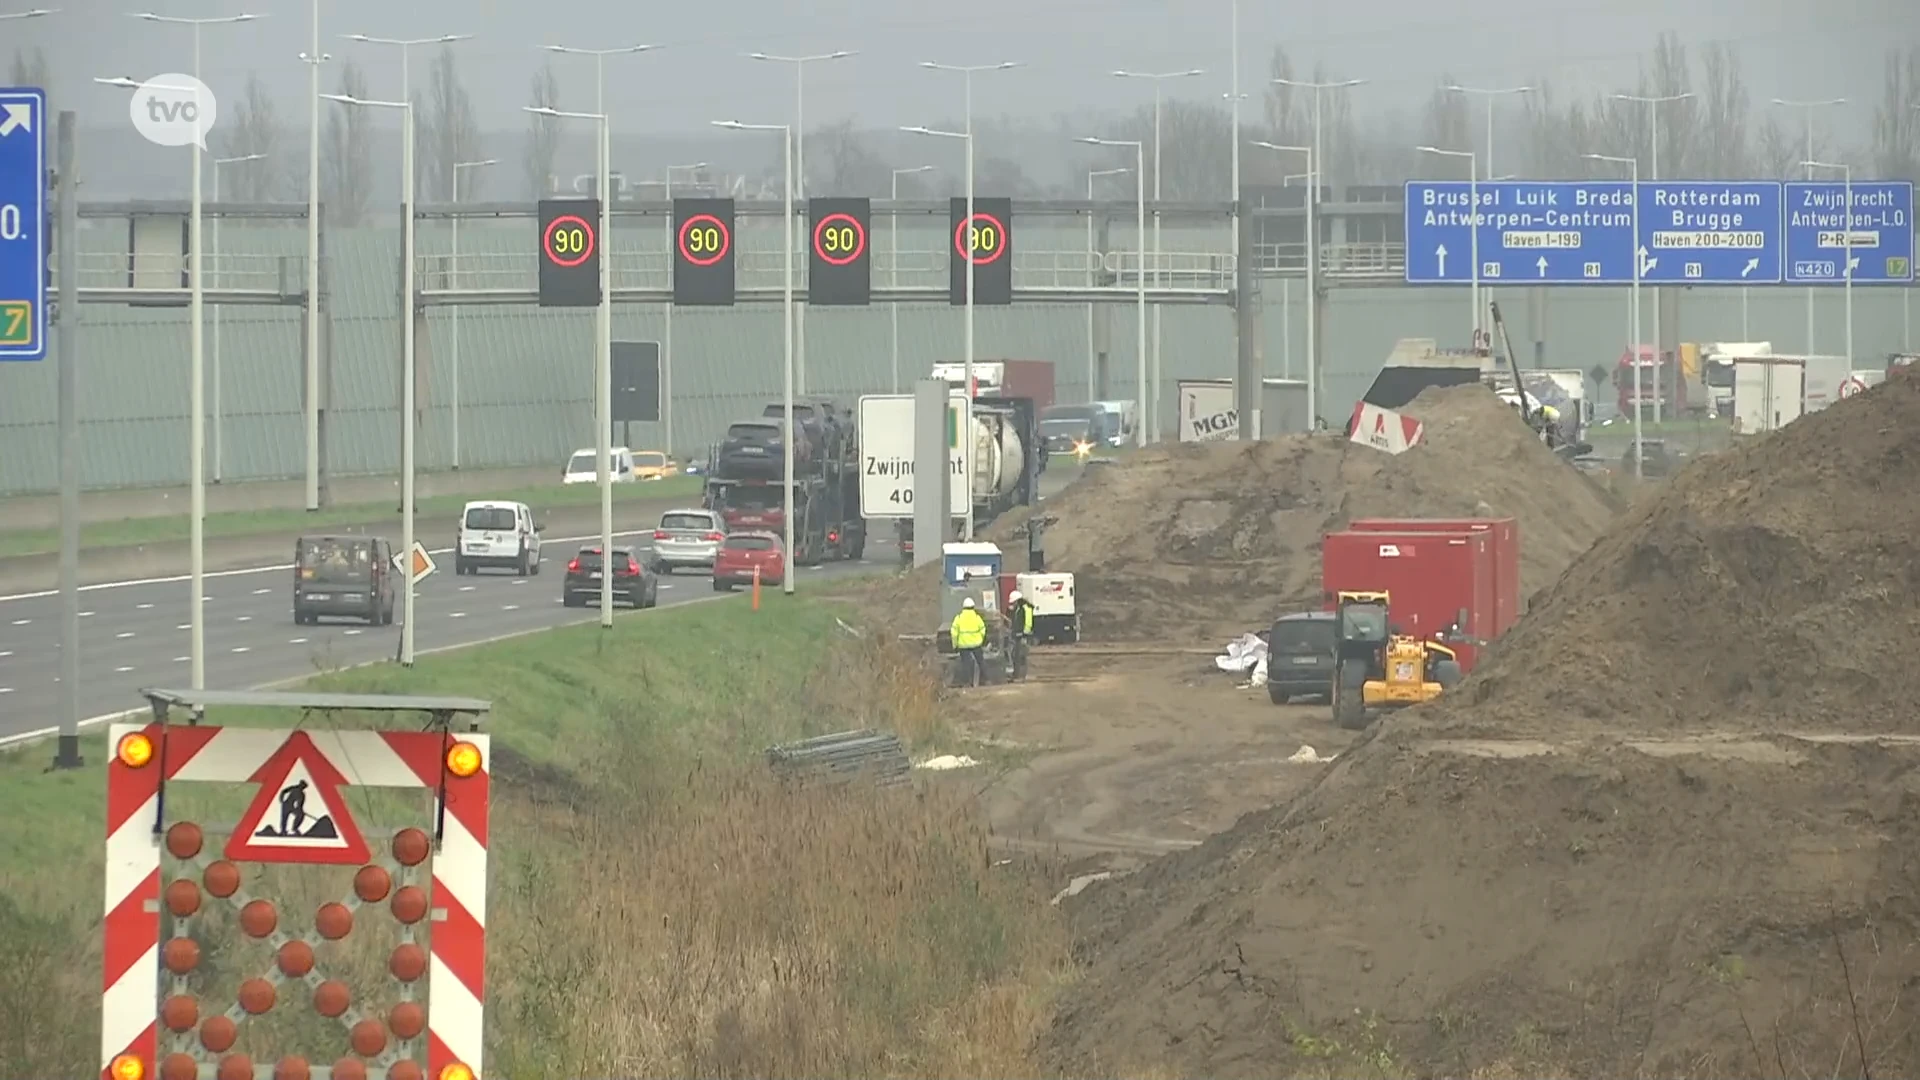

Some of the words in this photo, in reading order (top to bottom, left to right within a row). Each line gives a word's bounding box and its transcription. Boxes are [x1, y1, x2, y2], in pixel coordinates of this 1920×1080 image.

[1423, 188, 1500, 206] Brussel
[1516, 188, 1558, 206] Luik
[1576, 188, 1633, 206] Breda
[1655, 188, 1761, 206] Rotterdam
[1423, 209, 1631, 230] Antwerpen-Centrum
[1672, 209, 1743, 231] Brugge
[555, 228, 584, 253] 90
[689, 228, 719, 252] 90
[824, 227, 854, 251] 90
[1504, 233, 1541, 247] Haven
[1546, 233, 1579, 246] 1-199
[1654, 233, 1691, 247] Haven
[1695, 233, 1762, 246] 200-2000
[1485, 264, 1499, 275] R1
[1585, 264, 1599, 275] R1
[1686, 265, 1700, 276] R1
[1798, 263, 1832, 275] N420
[5, 308, 25, 336] 7
